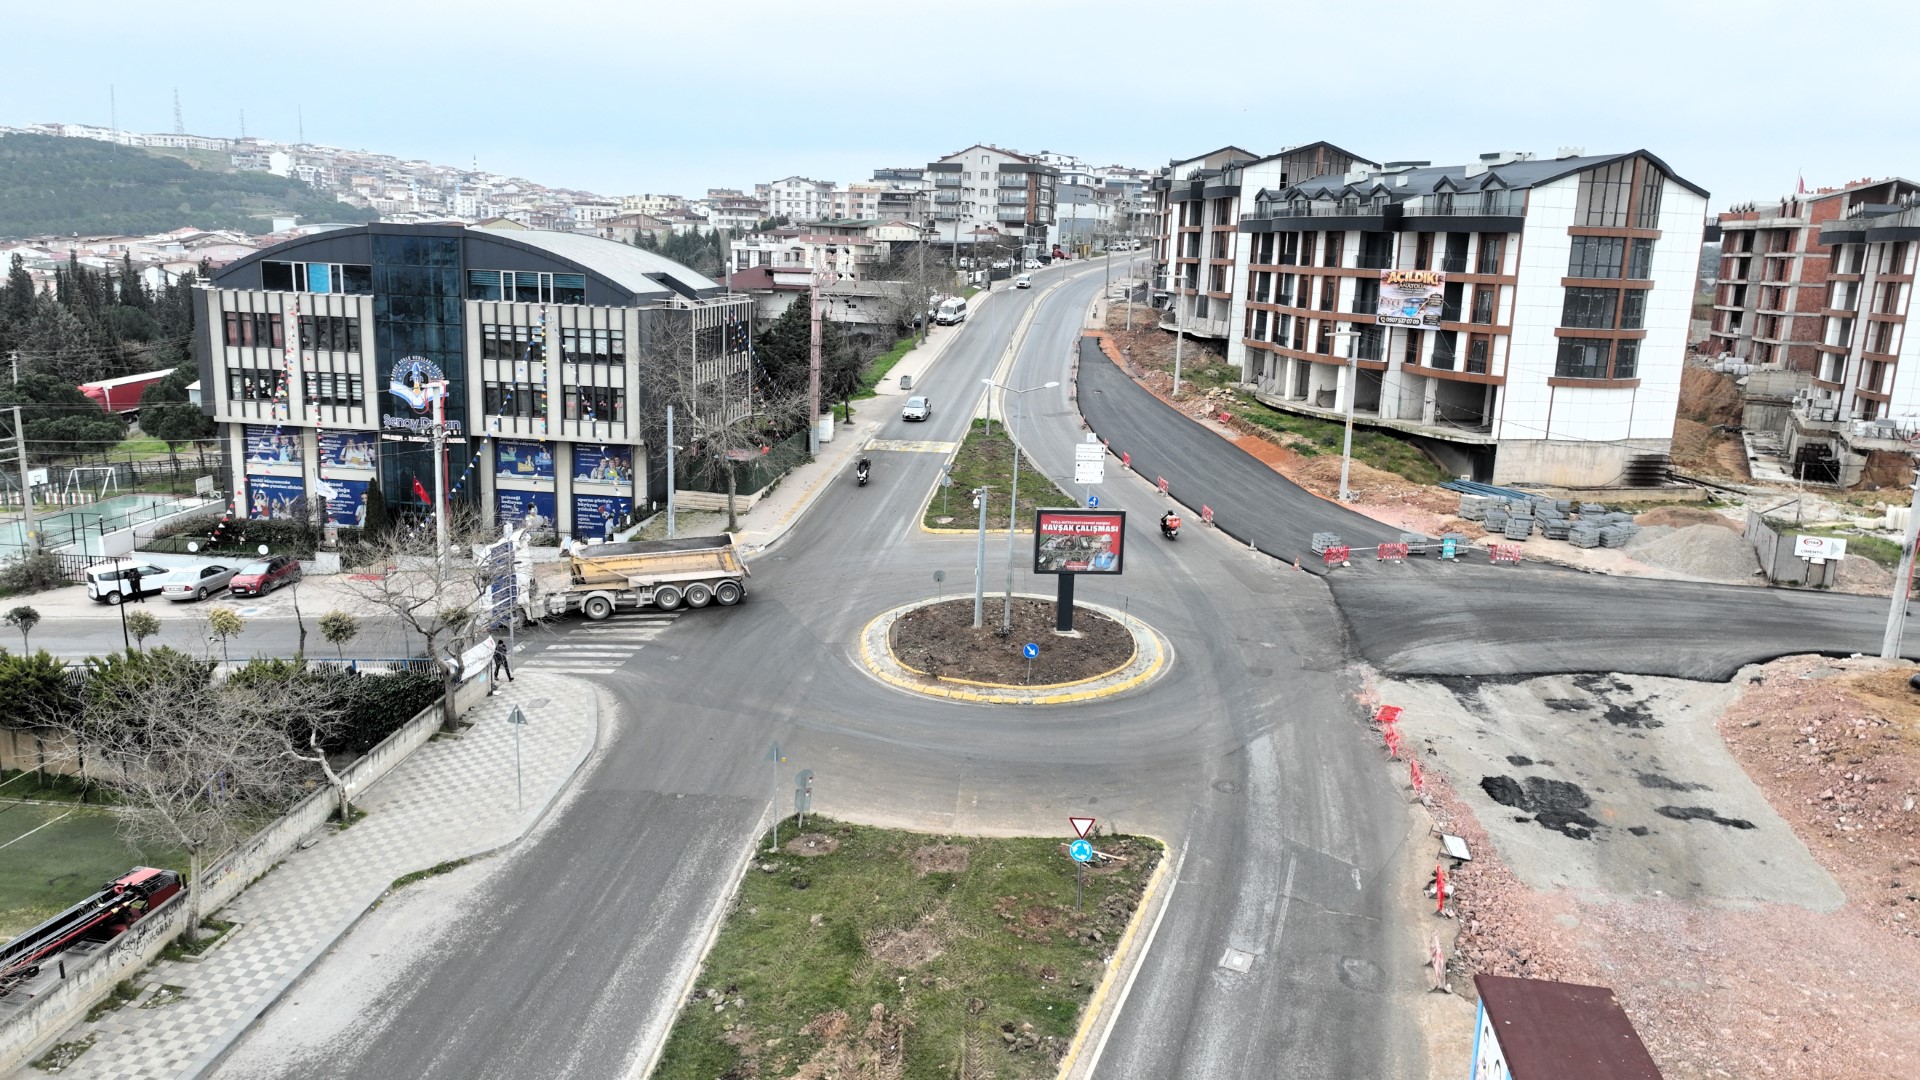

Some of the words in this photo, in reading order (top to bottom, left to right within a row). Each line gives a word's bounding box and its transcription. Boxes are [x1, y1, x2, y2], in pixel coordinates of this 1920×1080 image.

[419, 416, 461, 430] Dan
[1042, 523, 1075, 533] KAVŞAK
[1075, 524, 1119, 534] ÇALIŞMASI
